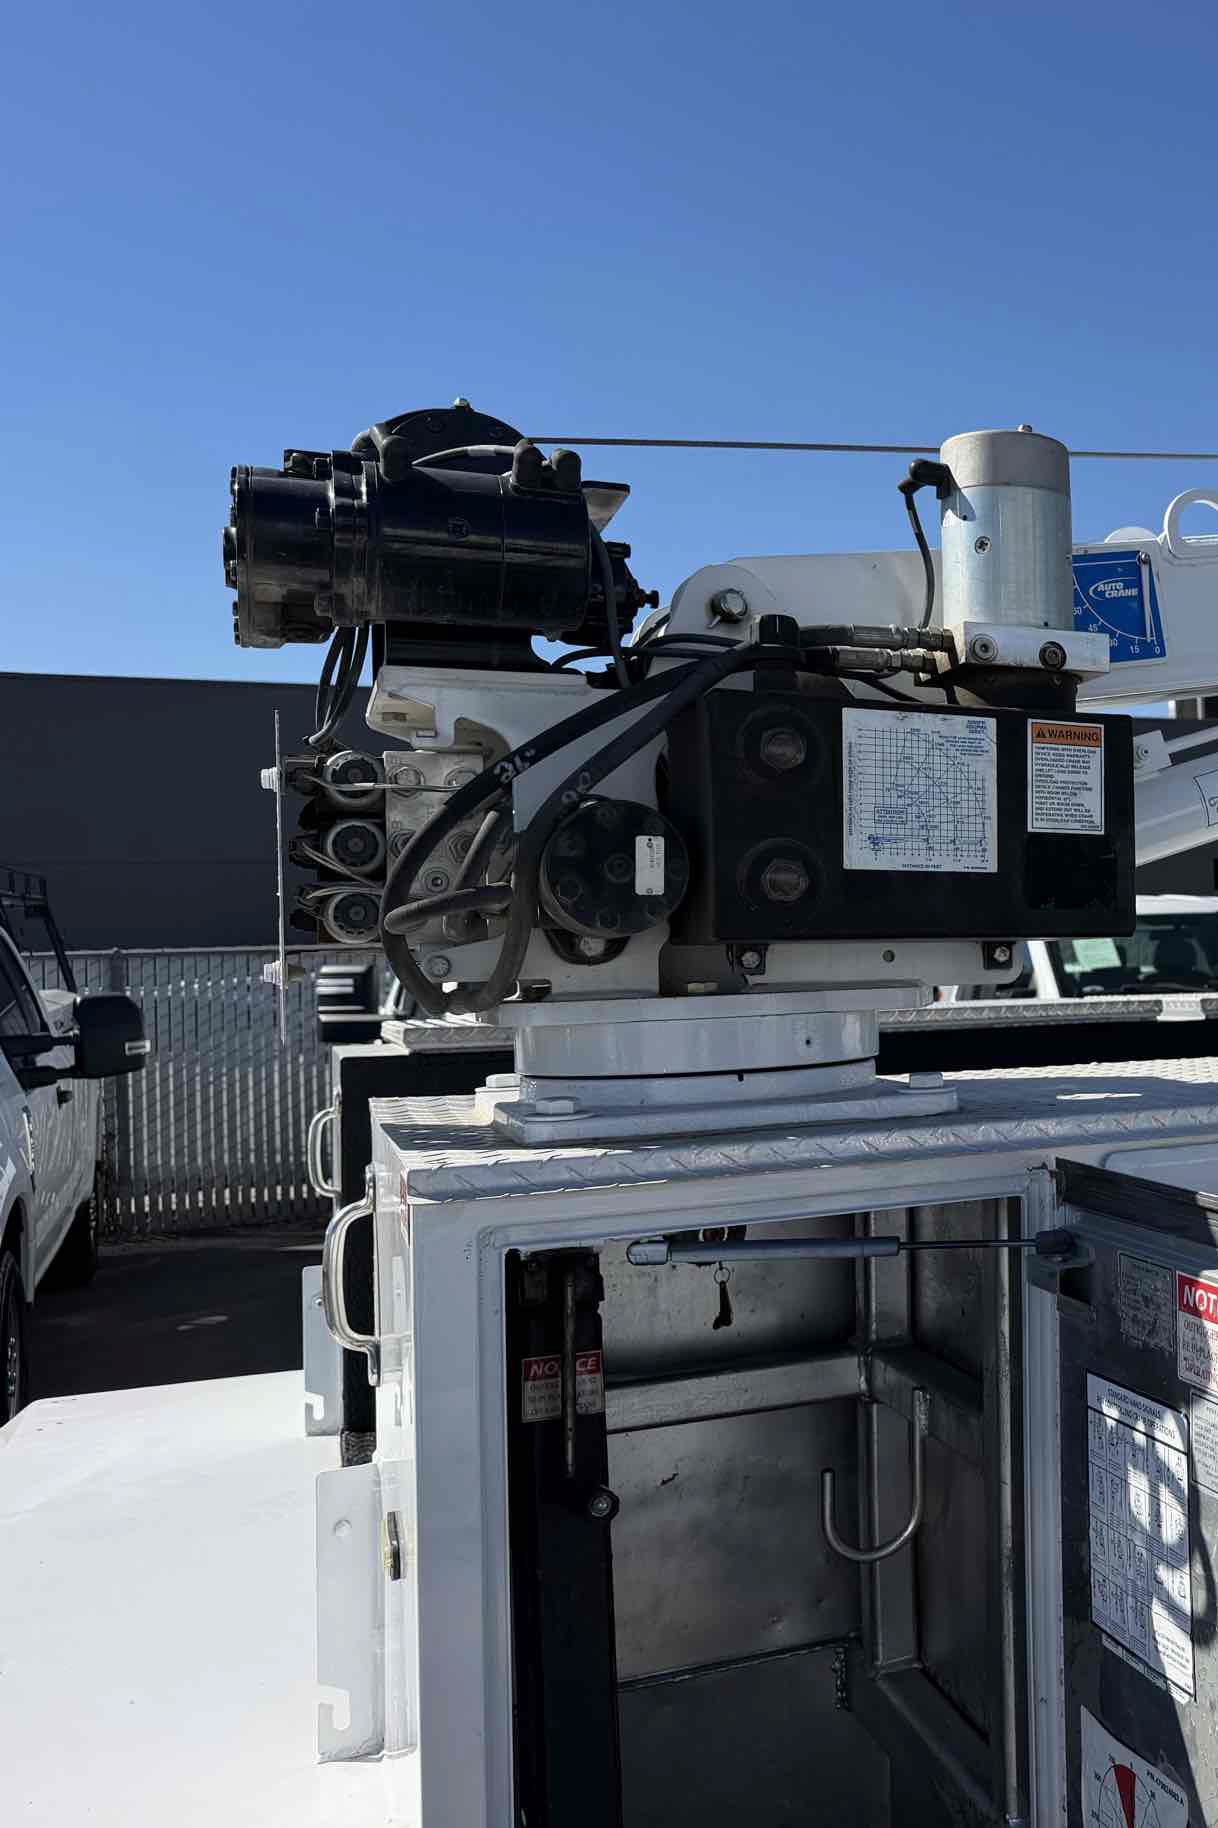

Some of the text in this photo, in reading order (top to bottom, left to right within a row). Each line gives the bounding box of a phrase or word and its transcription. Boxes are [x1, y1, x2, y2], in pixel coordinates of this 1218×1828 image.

[1097, 582, 1124, 592] AUTO
[1105, 587, 1138, 599] CRANE
[1130, 645, 1140, 654] 15
[1154, 646, 1161, 654] 0
[1048, 727, 1098, 742] WARNING
[529, 1357, 597, 1376] NOCE
